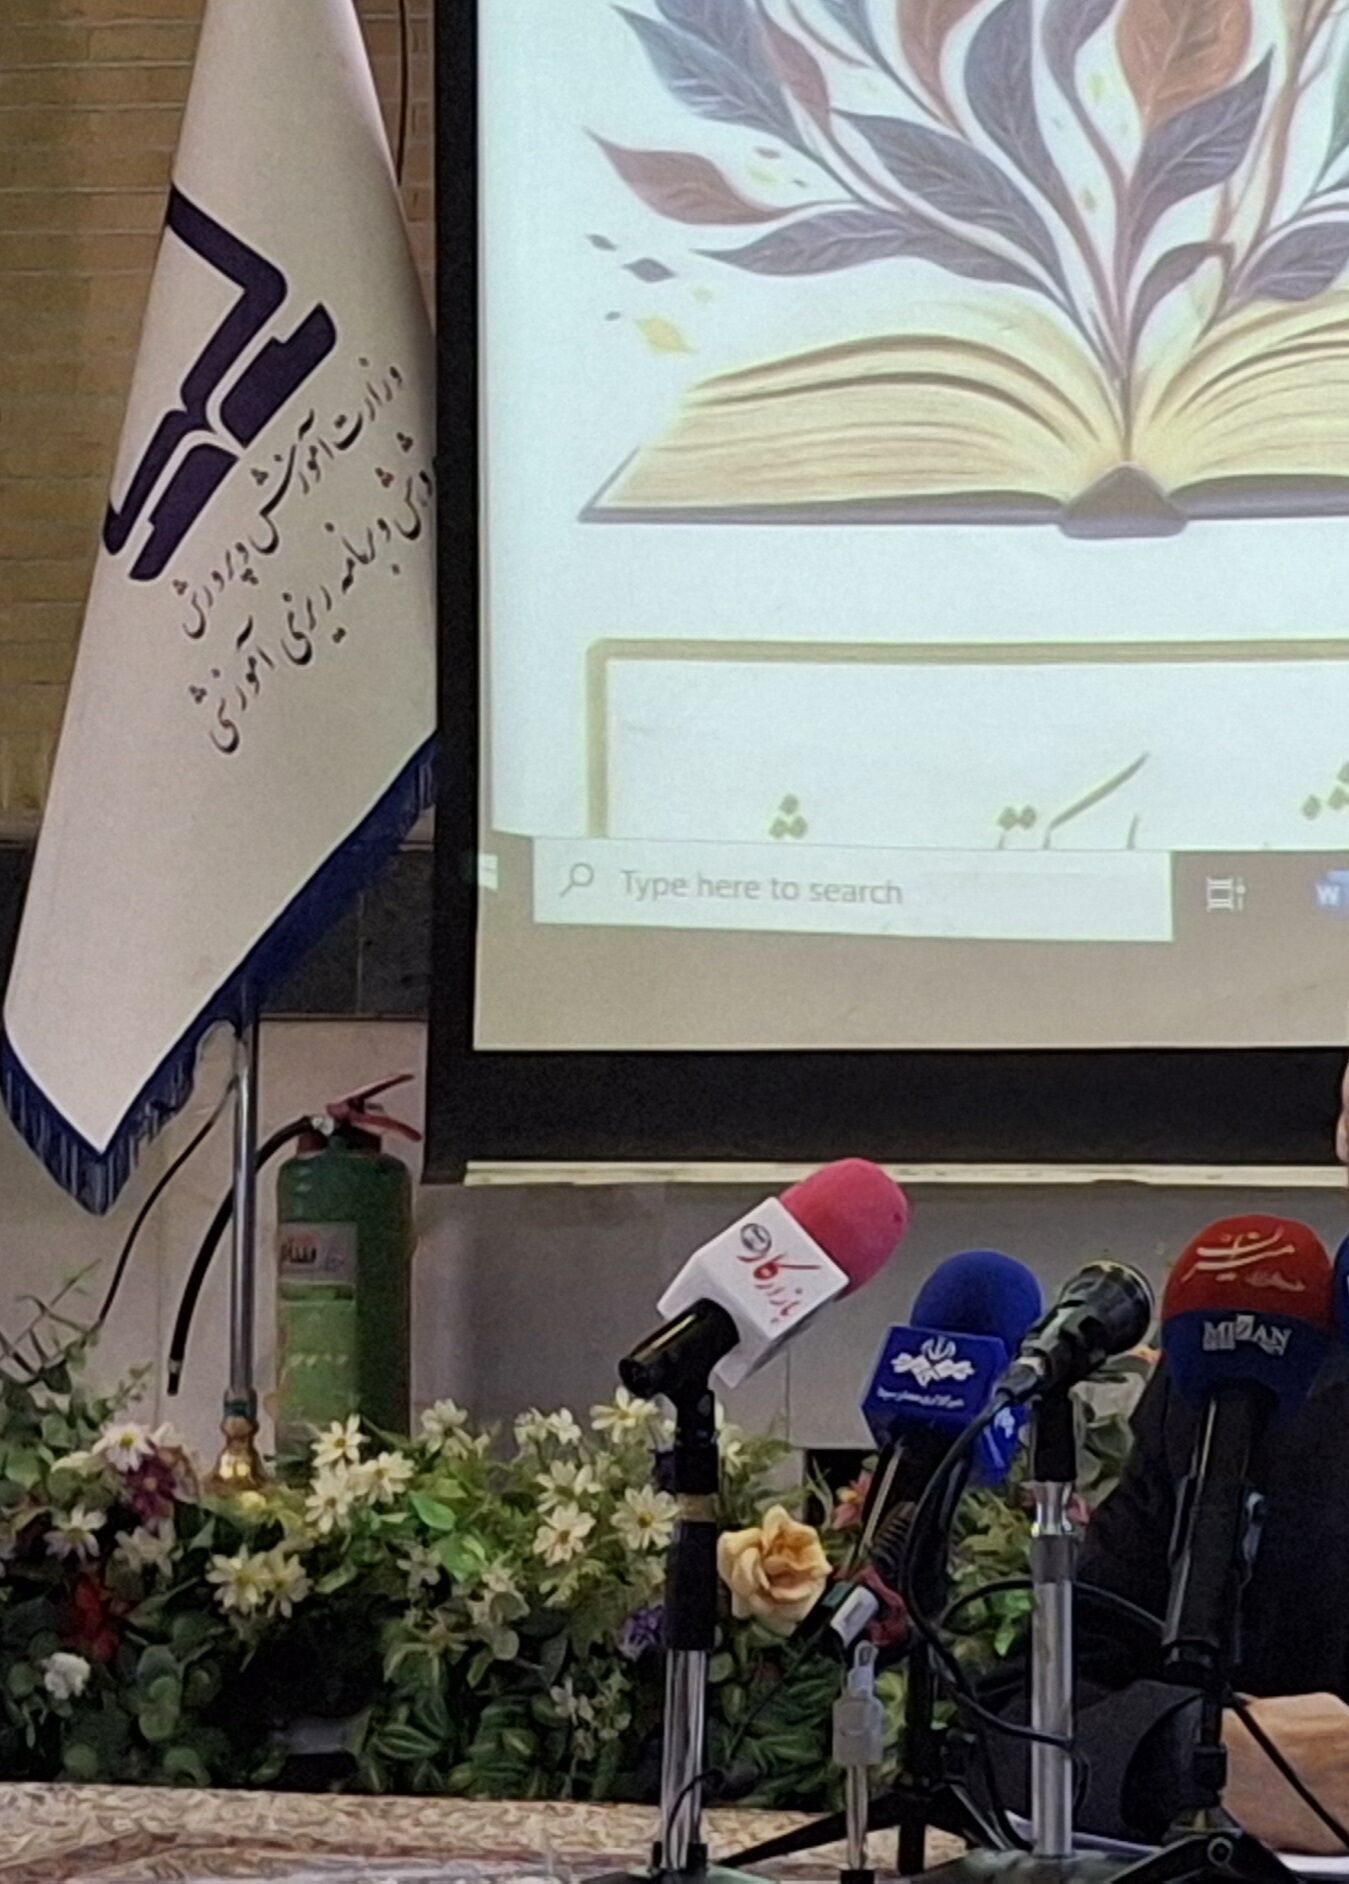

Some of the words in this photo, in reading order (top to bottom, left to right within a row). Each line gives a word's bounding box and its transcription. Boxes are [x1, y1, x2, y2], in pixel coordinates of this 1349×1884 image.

[332, 355, 404, 452] وزارت
[247, 406, 336, 556] آموزش
[234, 540, 250, 566] و
[323, 520, 401, 596] برنامه
[375, 516, 392, 543] و
[171, 547, 260, 641] پرورش
[279, 583, 348, 668] ریزی
[188, 612, 276, 756] آموزشی
[621, 868, 688, 900] Type
[696, 872, 761, 900] here
[770, 876, 801, 900] to
[808, 879, 904, 905] search
[1202, 1314, 1293, 1357] MIZAN
